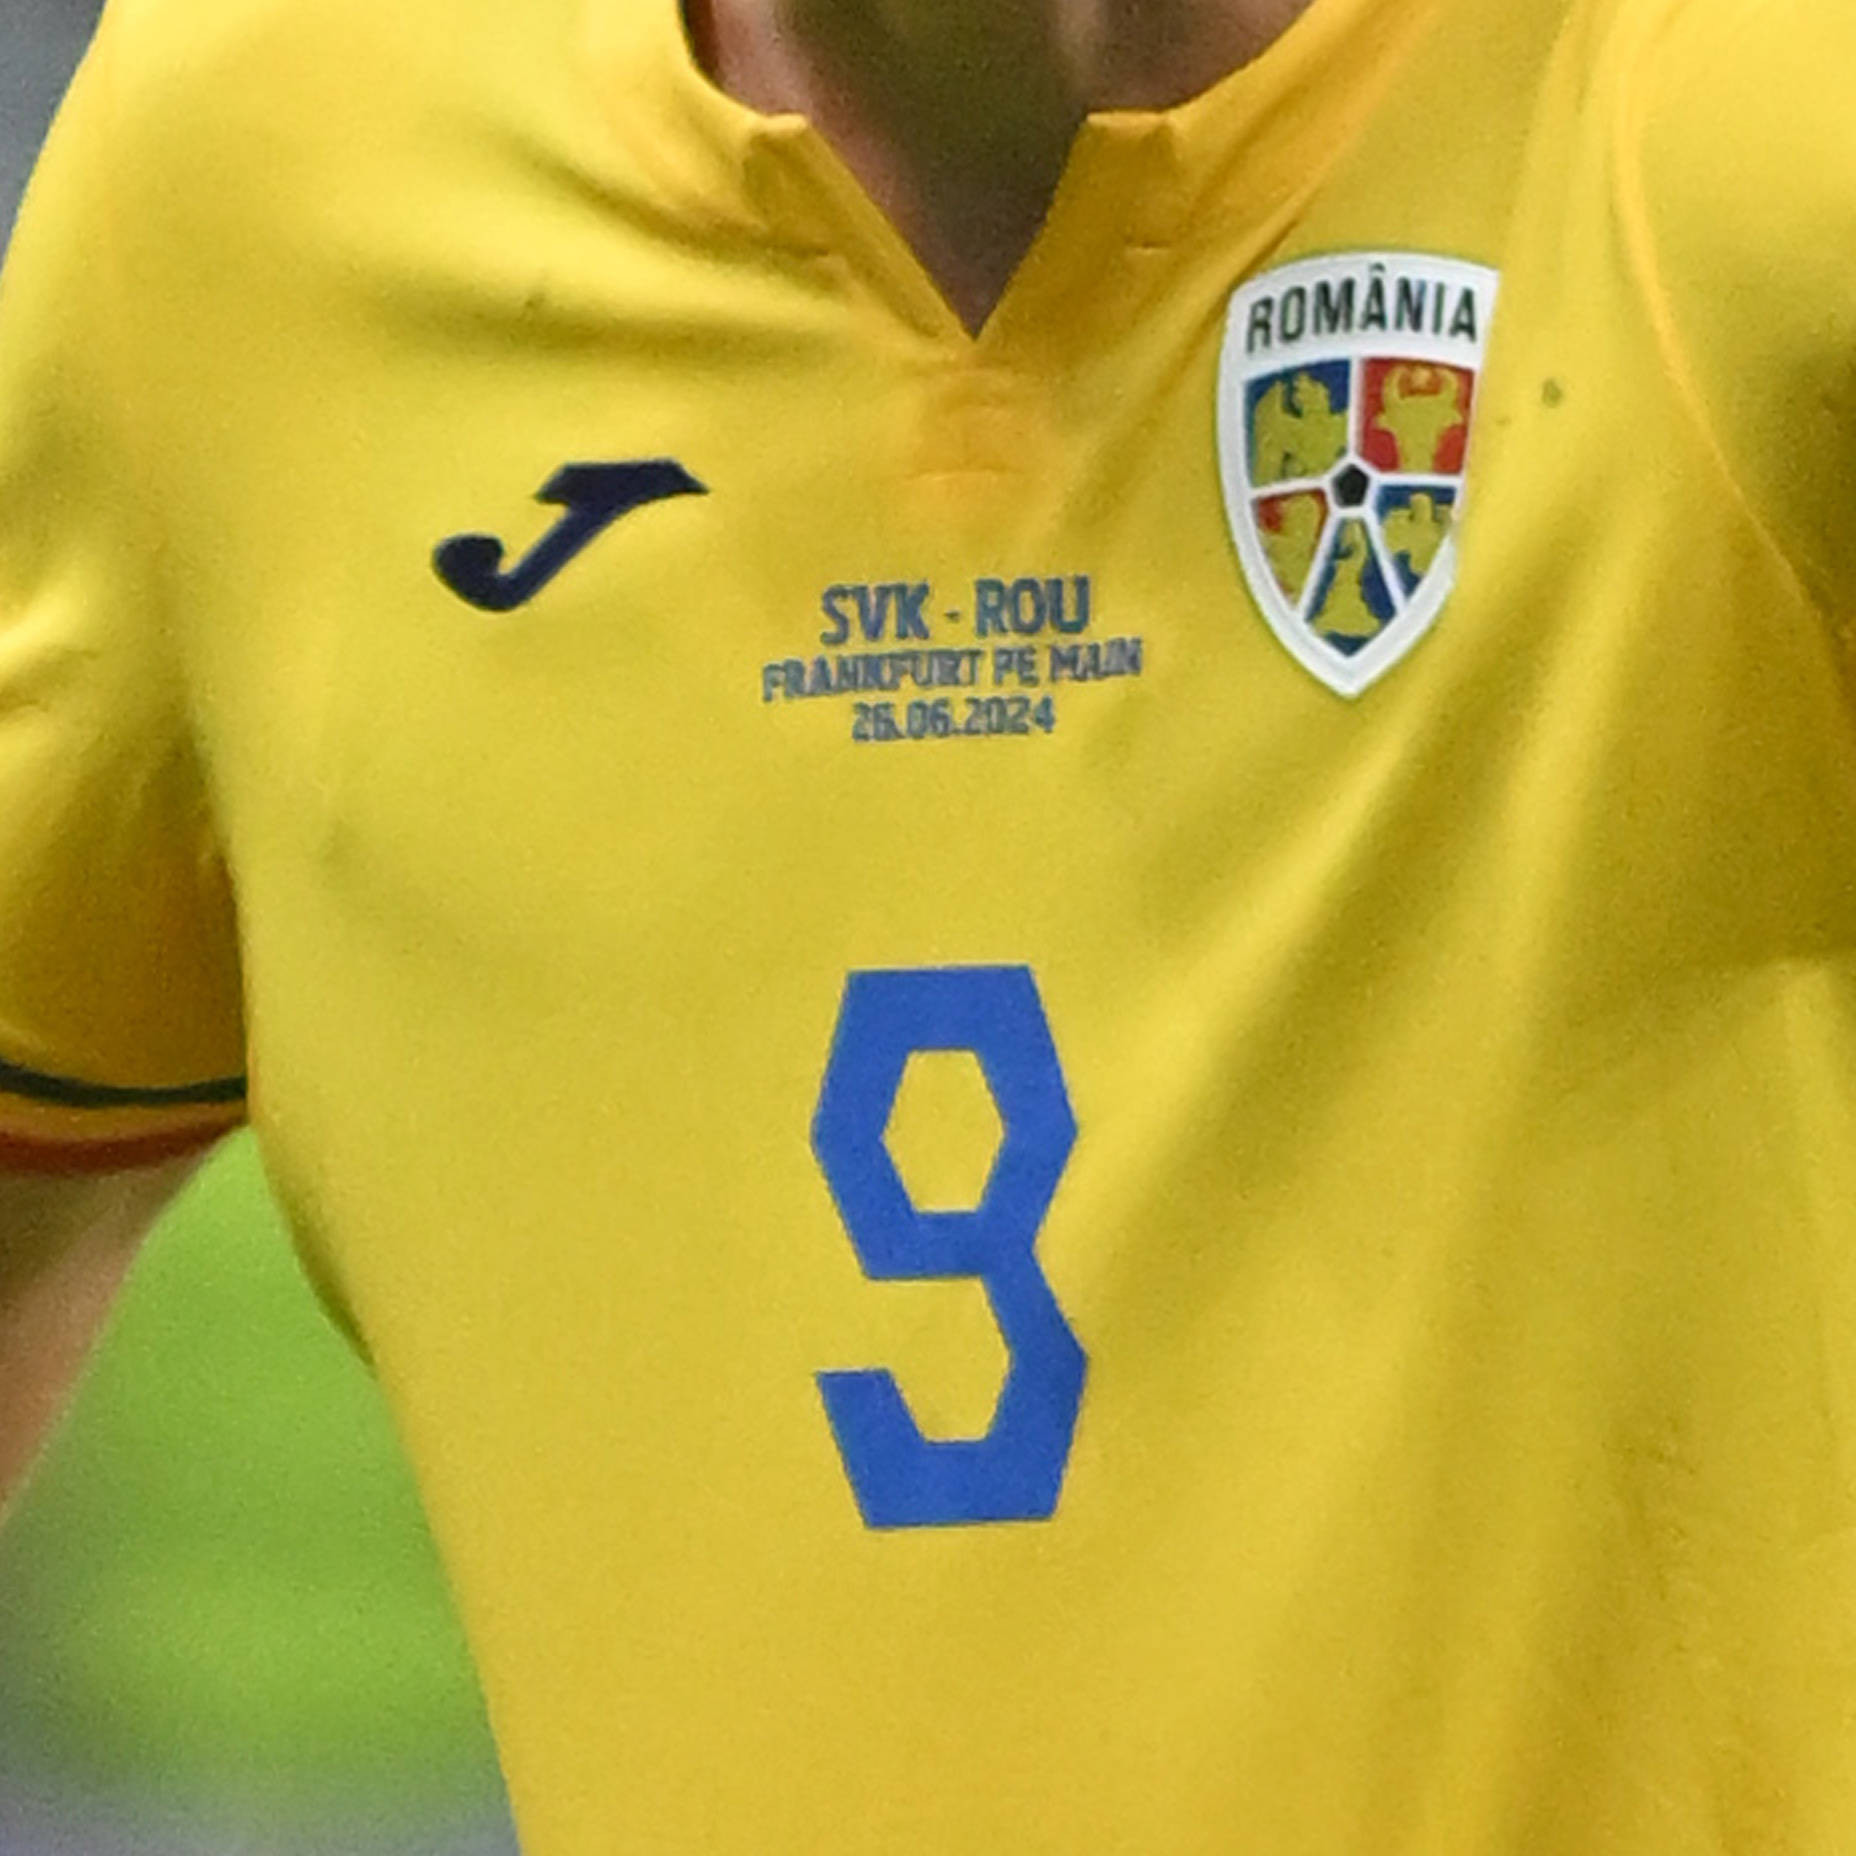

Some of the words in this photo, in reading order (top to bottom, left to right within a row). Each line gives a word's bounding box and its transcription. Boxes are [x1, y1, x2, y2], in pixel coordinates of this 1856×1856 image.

[1246, 262, 1479, 353] ROMÂNIA
[819, 579, 931, 645] SVK
[973, 574, 1091, 637] ROU
[761, 649, 984, 703] FRANKFURT
[993, 645, 1039, 687] PE
[1047, 637, 1143, 683] MAIN
[851, 694, 1057, 742] 26.06.2024
[809, 964, 1088, 1530] 9
